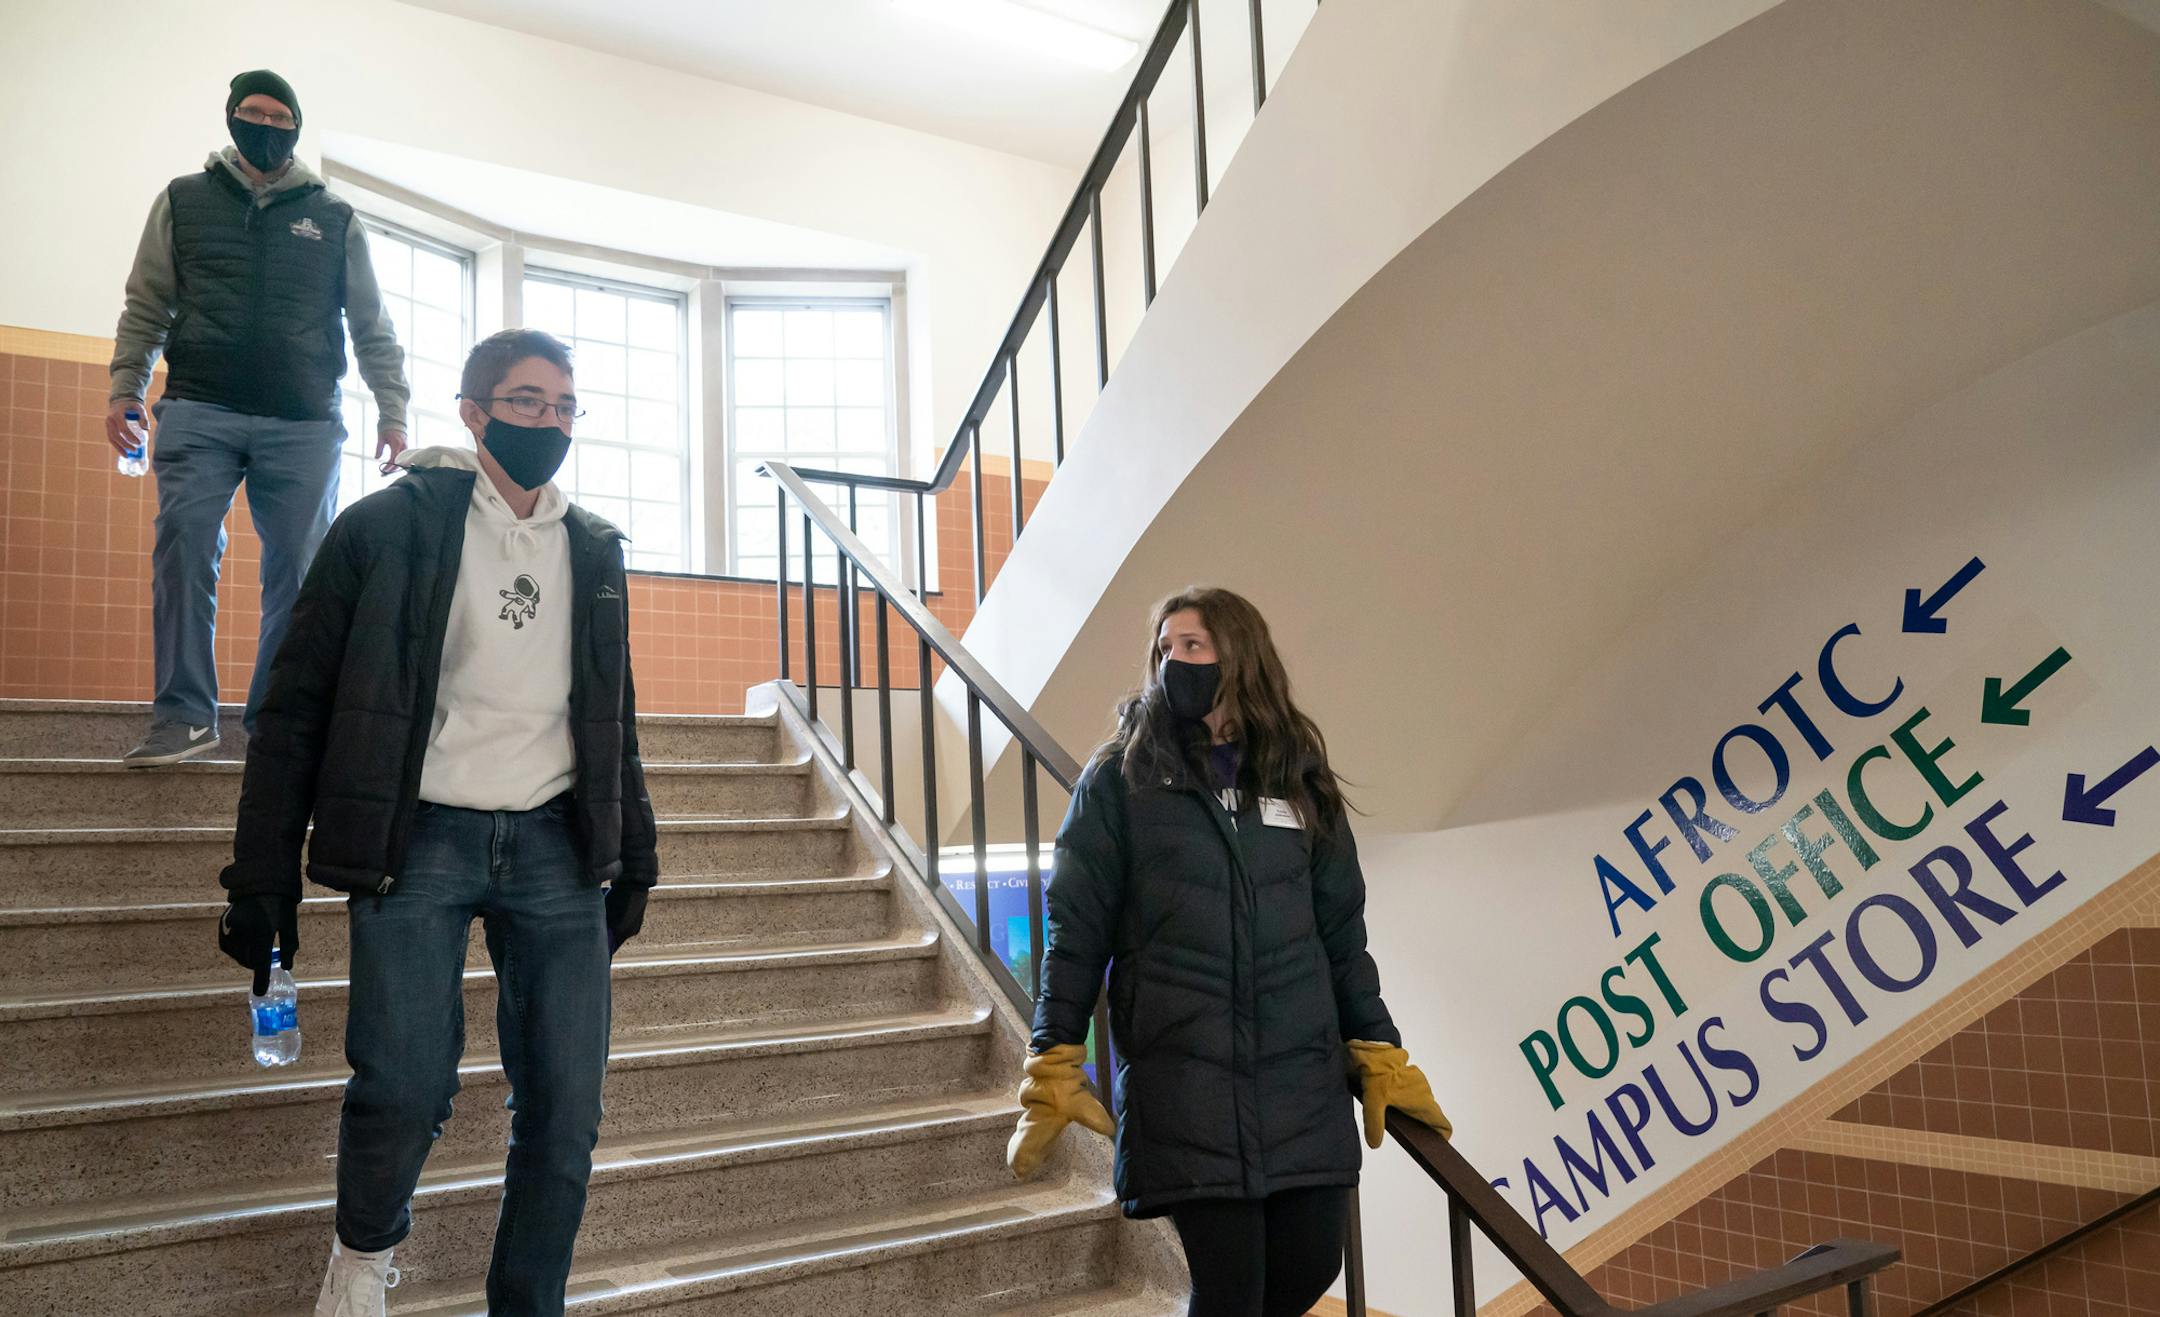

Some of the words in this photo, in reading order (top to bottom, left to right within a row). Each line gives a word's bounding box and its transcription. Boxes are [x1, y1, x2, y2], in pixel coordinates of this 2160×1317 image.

[1518, 932, 1689, 1111] POST
[1699, 706, 1985, 964] OFFICE
[1593, 623, 1905, 938] AFROTC
[1489, 1016, 1760, 1241] AMPUS
[1759, 800, 2068, 1062] STORE
